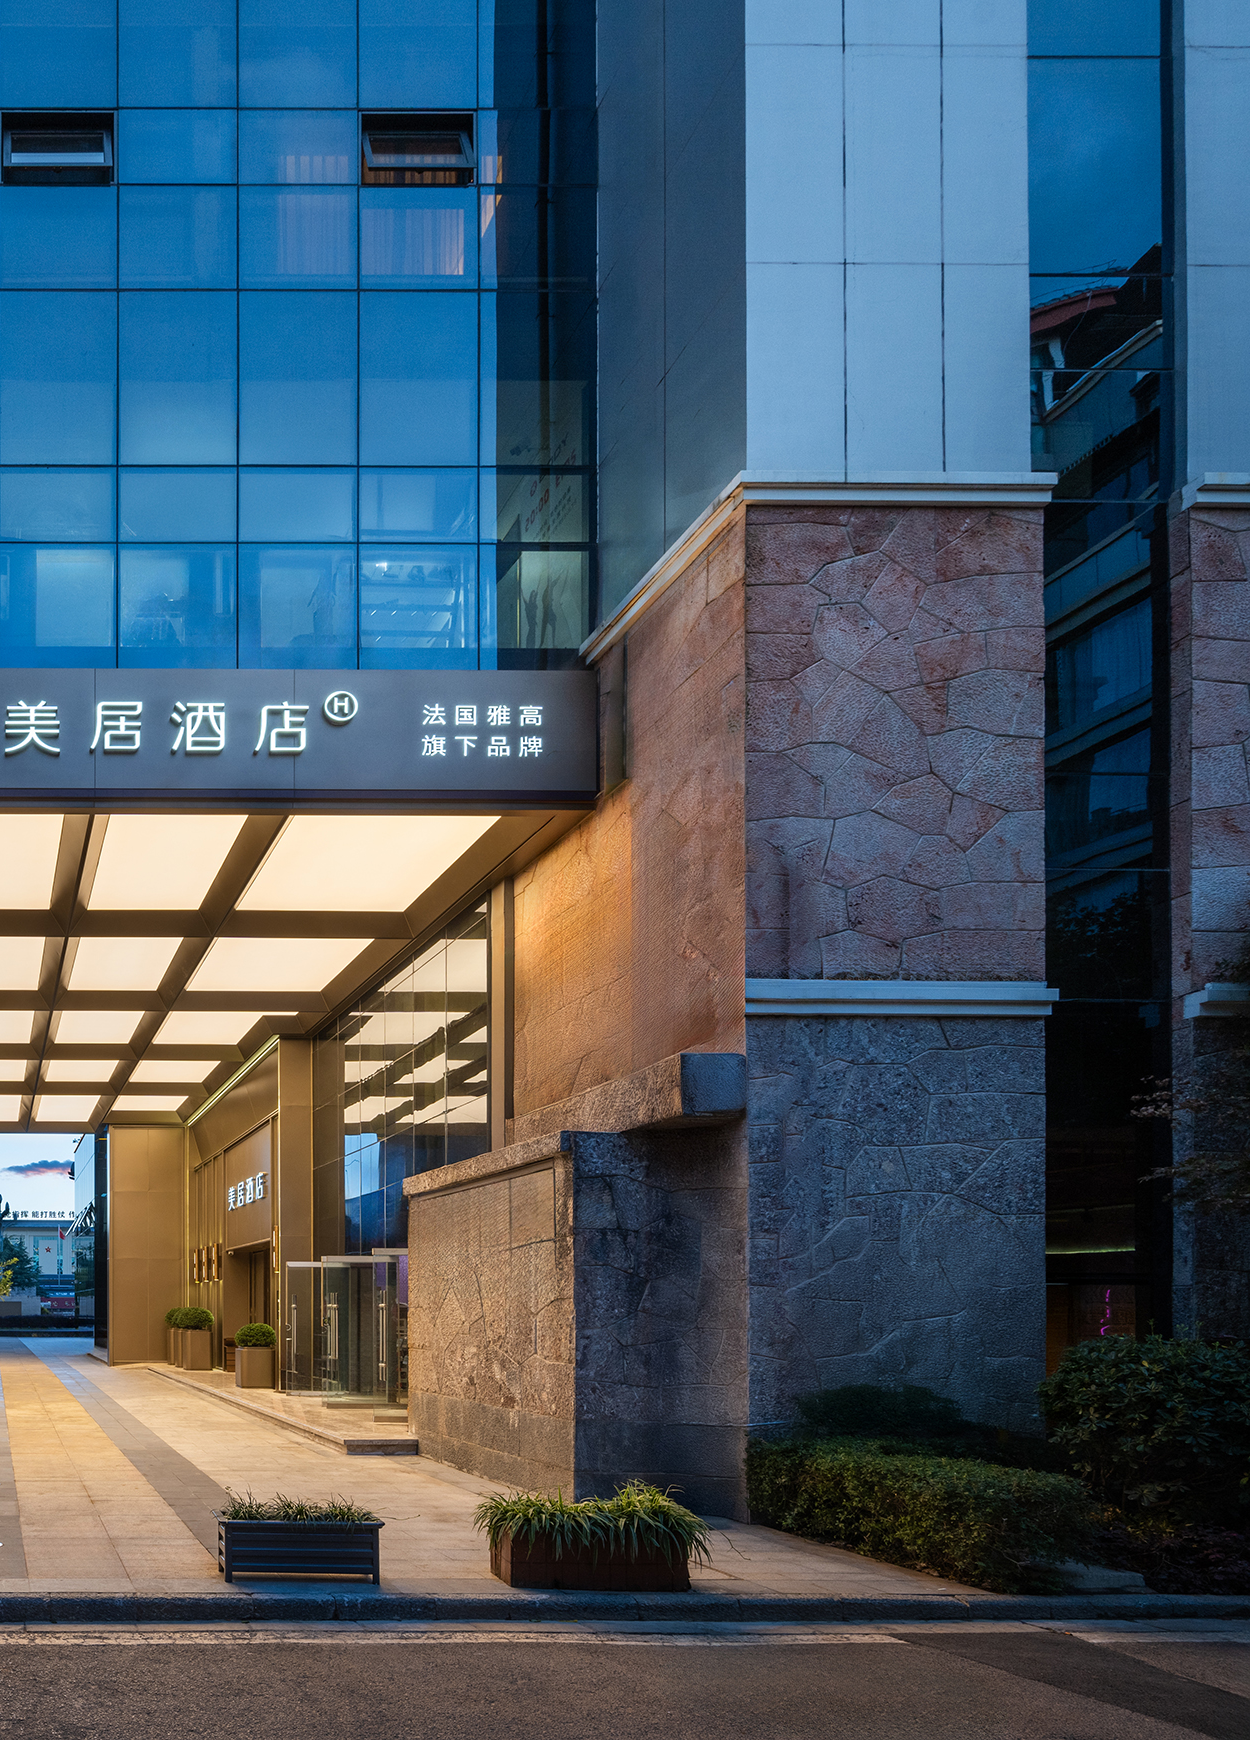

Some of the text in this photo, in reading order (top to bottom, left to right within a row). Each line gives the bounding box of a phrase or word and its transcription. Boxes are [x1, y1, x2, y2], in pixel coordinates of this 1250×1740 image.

[4, 699, 310, 753] 美居酒店
[422, 703, 543, 727] 法国雅高
[421, 734, 543, 758] 旗下品牌
[228, 1172, 264, 1211] 美居酒店
